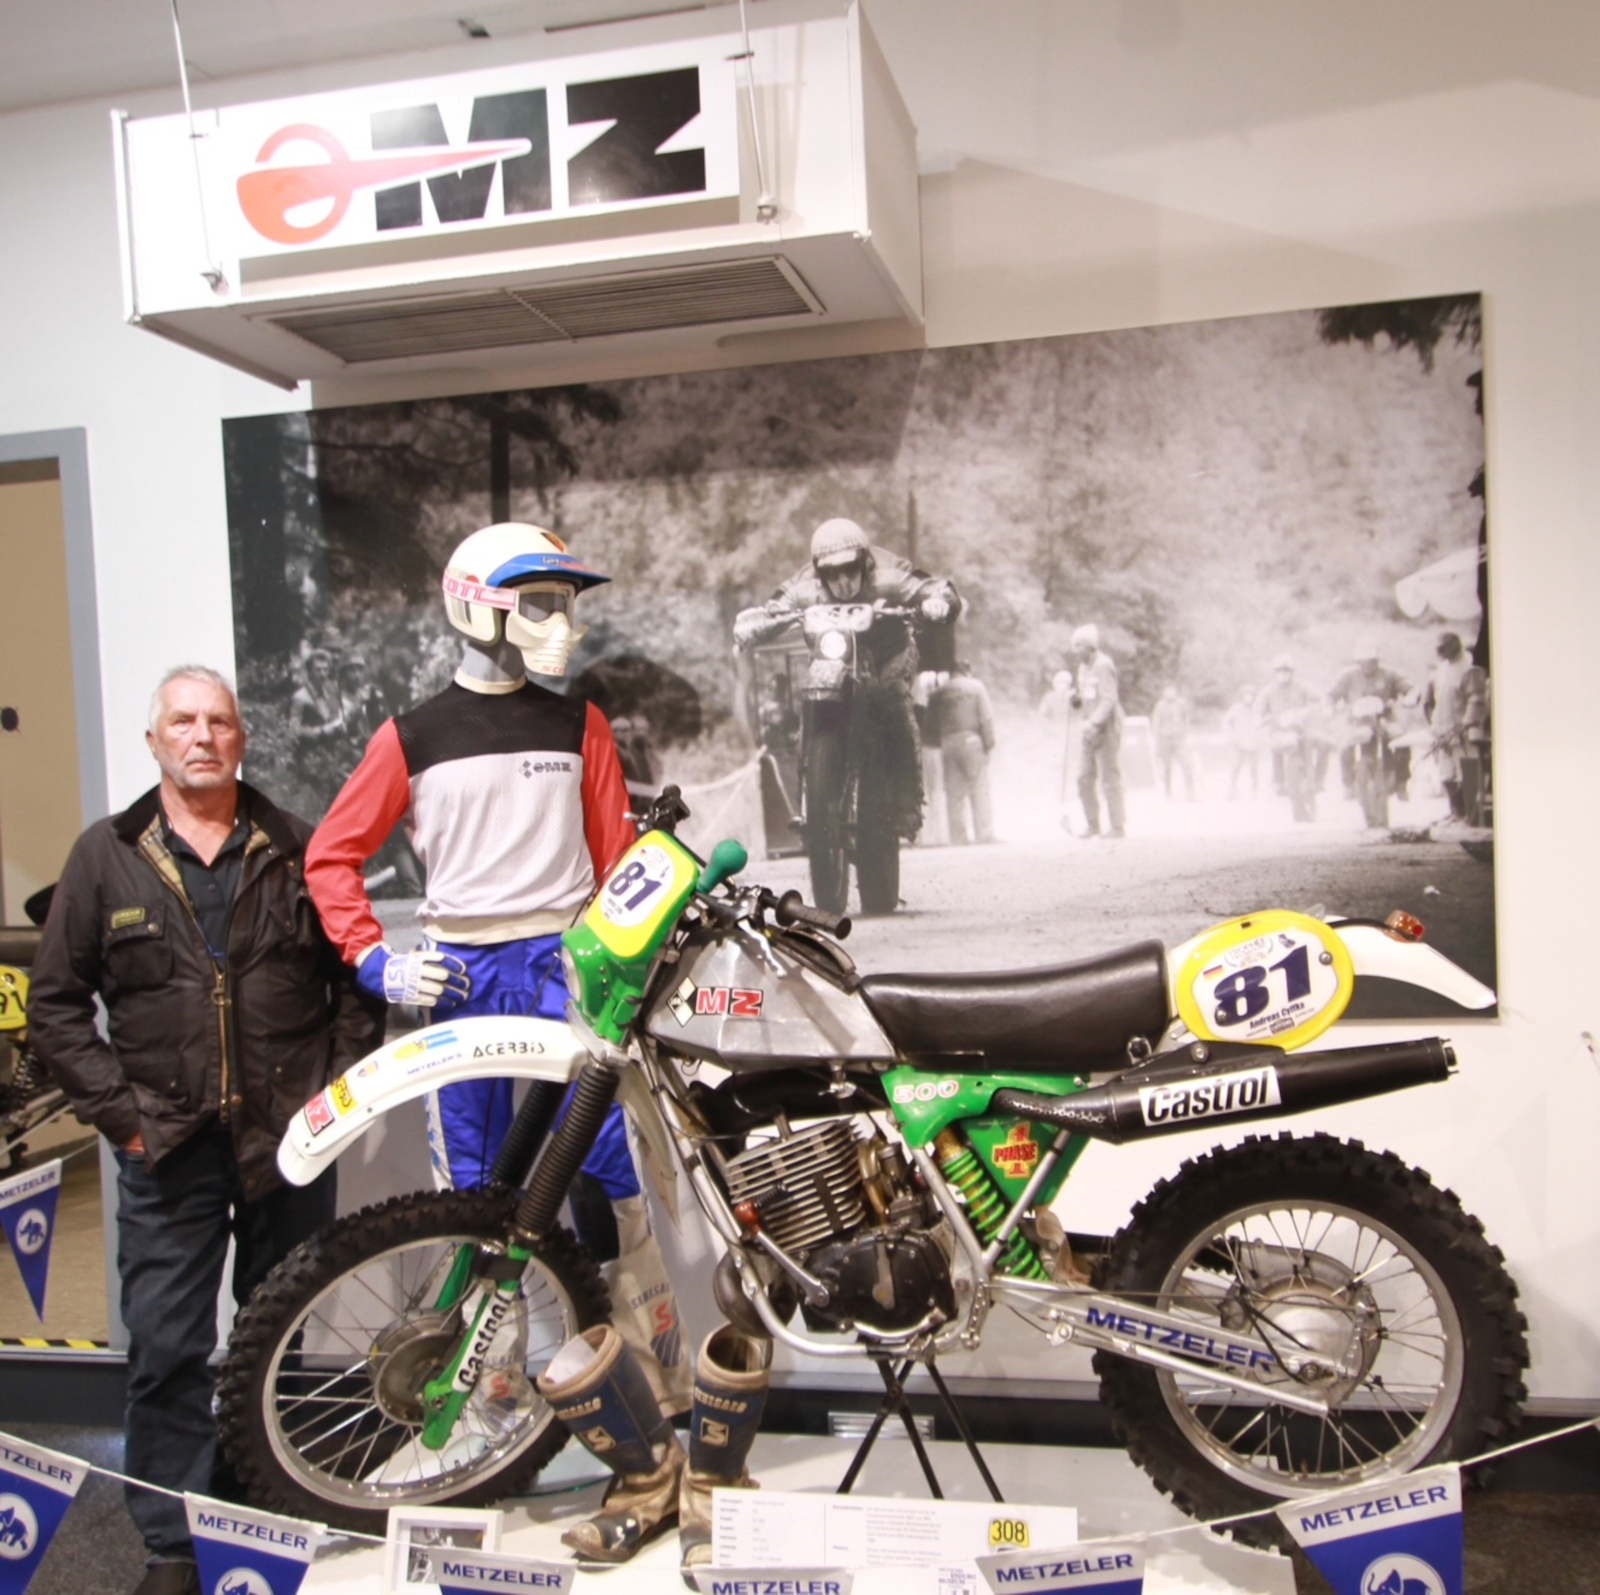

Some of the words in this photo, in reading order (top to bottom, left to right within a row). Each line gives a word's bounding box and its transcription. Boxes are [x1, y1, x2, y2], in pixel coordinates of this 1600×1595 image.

[371, 66, 706, 232] MZ
[608, 861, 662, 912] 81
[697, 988, 763, 1015] MZ
[1214, 945, 1311, 1027] 81
[893, 1080, 959, 1104] 500
[1147, 1070, 1269, 1122] Castrol
[994, 1142, 1036, 1162] PHASE
[458, 1291, 513, 1387] Castrol
[1086, 1307, 1276, 1373] METZELER
[0, 1447, 73, 1484] TZELER
[1300, 1485, 1449, 1533] METZELER
[197, 1512, 309, 1550] METZELER
[992, 1519, 1025, 1543] 308
[442, 1562, 562, 1588] METZELER
[996, 1554, 1134, 1583] METZELER
[712, 1581, 841, 1595] METZELER
